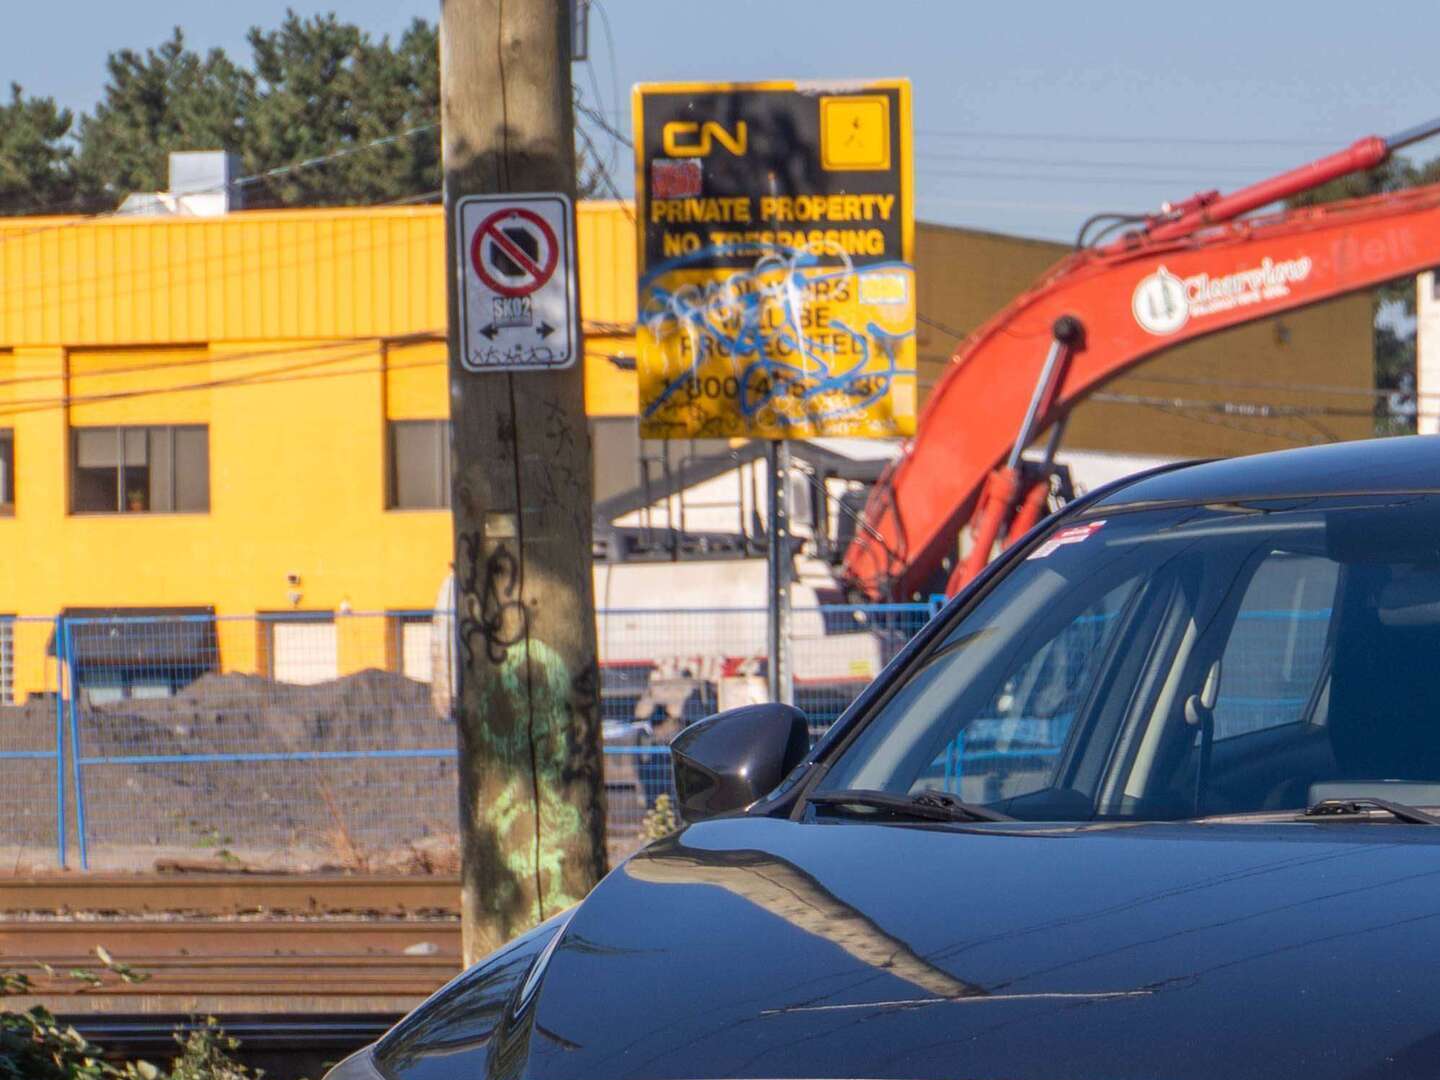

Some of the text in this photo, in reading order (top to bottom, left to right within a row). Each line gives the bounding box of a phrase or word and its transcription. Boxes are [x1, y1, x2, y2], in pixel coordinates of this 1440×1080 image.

[662, 120, 748, 157] CN
[652, 194, 895, 223] PRIVATE PROPERTY
[663, 228, 885, 257] NO TRESPASSING
[1184, 256, 1312, 303] Clearview
